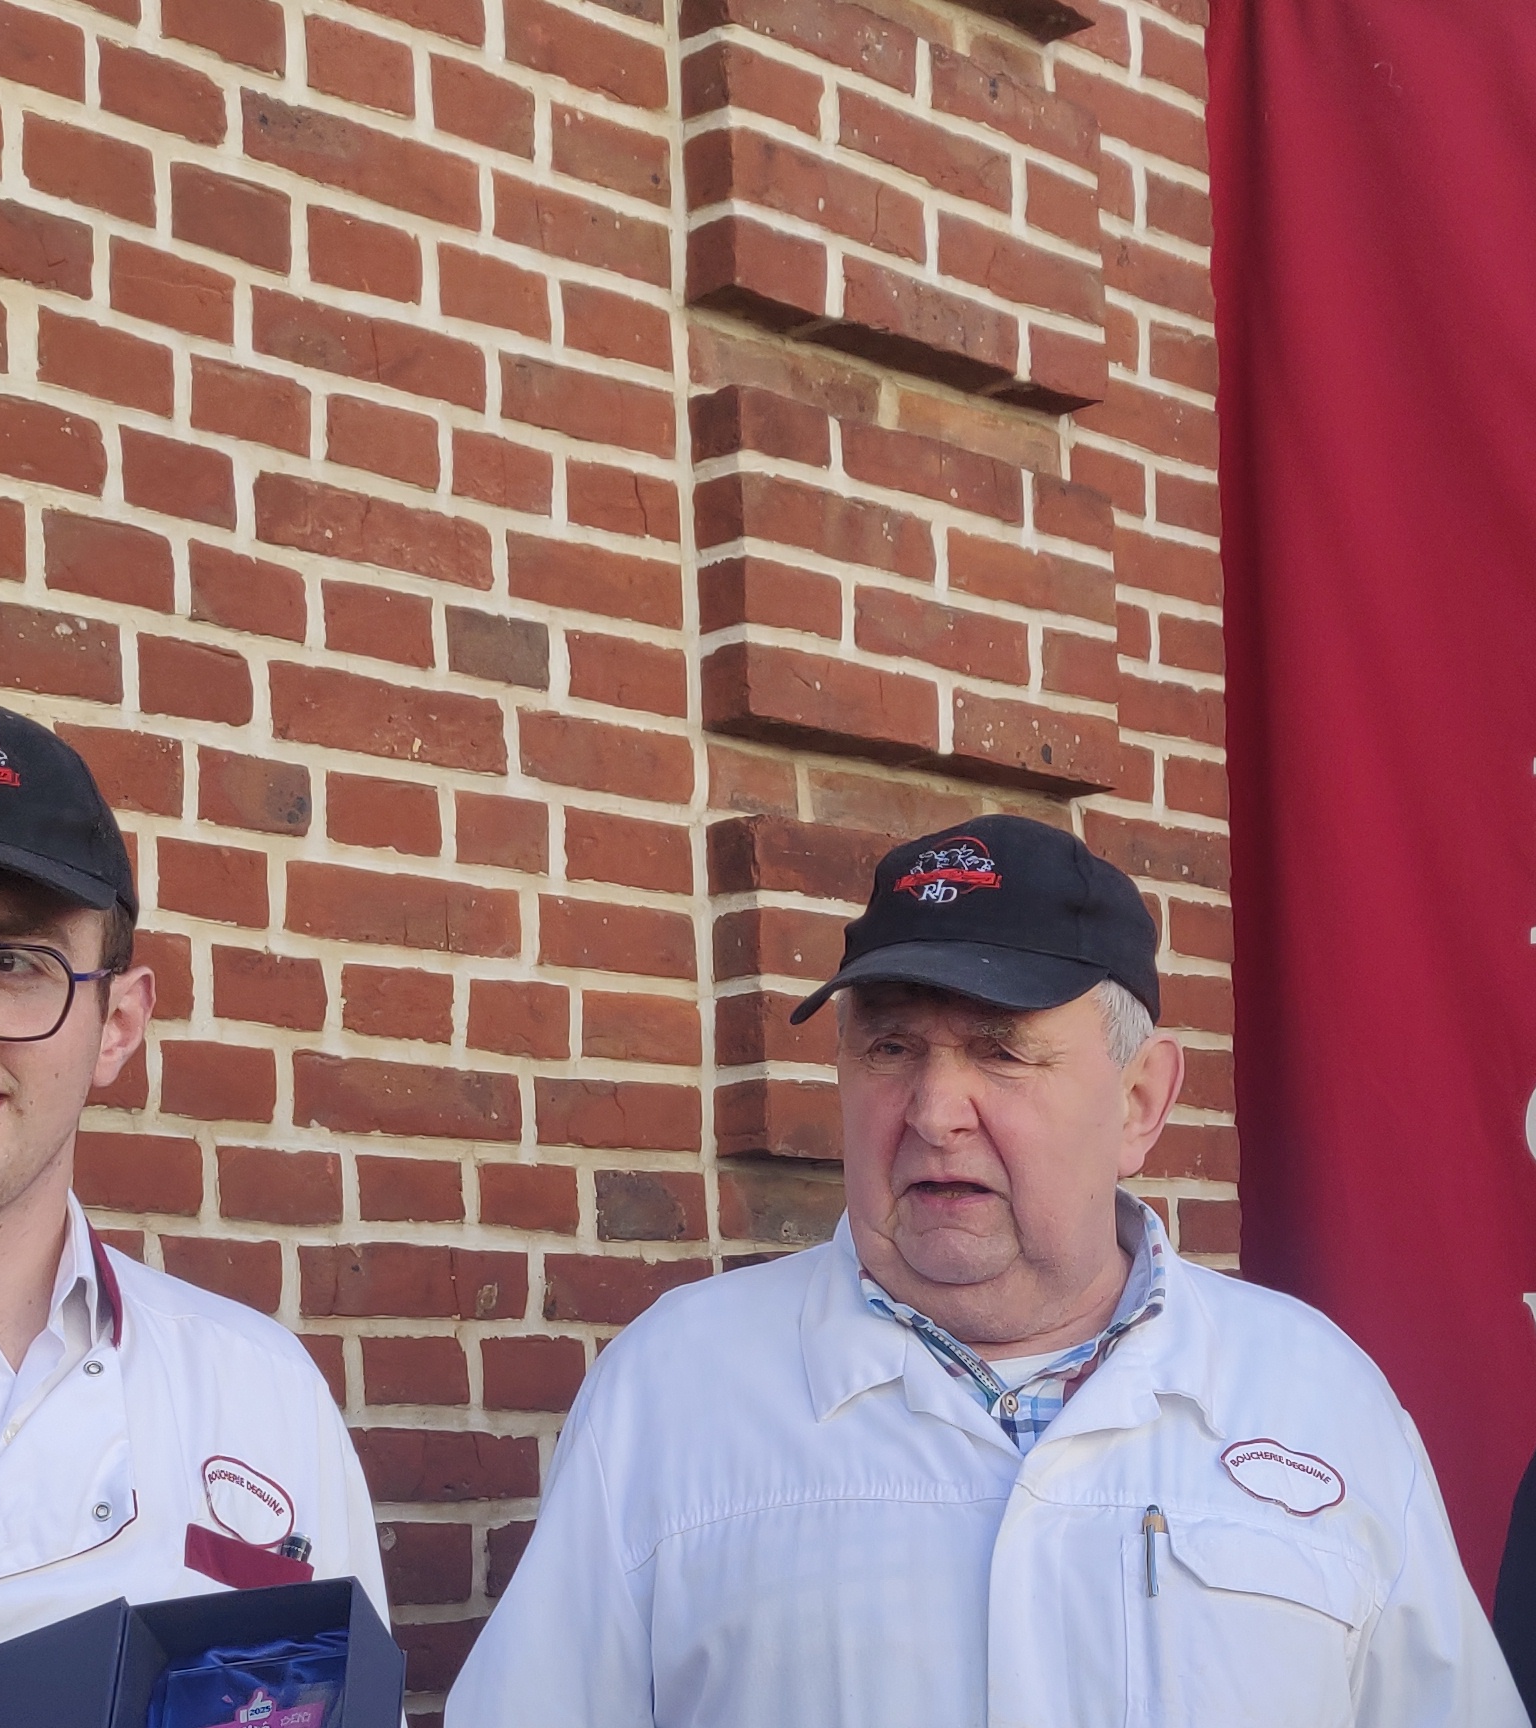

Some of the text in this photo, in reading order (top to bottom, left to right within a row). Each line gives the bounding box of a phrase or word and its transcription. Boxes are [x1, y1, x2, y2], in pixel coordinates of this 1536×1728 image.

[1230, 1451, 1332, 1485] BOUCHERIE DEGUINE
[208, 1469, 284, 1517] BOUCHERIE DEGUINE
[249, 1705, 272, 1717] 2025
